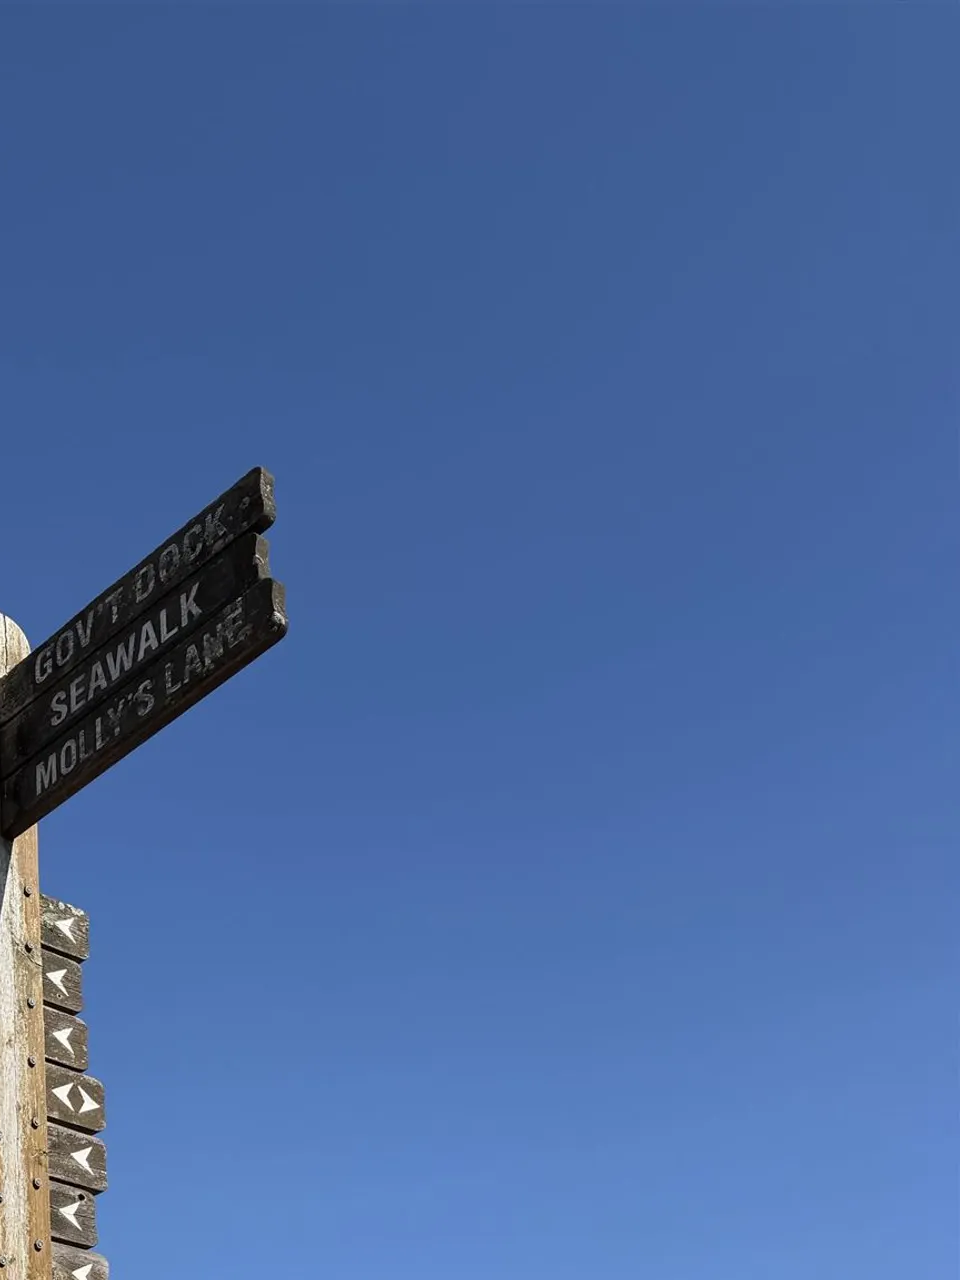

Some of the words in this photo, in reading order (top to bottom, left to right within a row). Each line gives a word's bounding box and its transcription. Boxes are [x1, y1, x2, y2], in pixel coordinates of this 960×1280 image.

[34, 585, 128, 686] GOV'T
[135, 502, 229, 604] DOCK
[49, 581, 203, 728] SEAWALK
[35, 680, 157, 796] MOLLY'S
